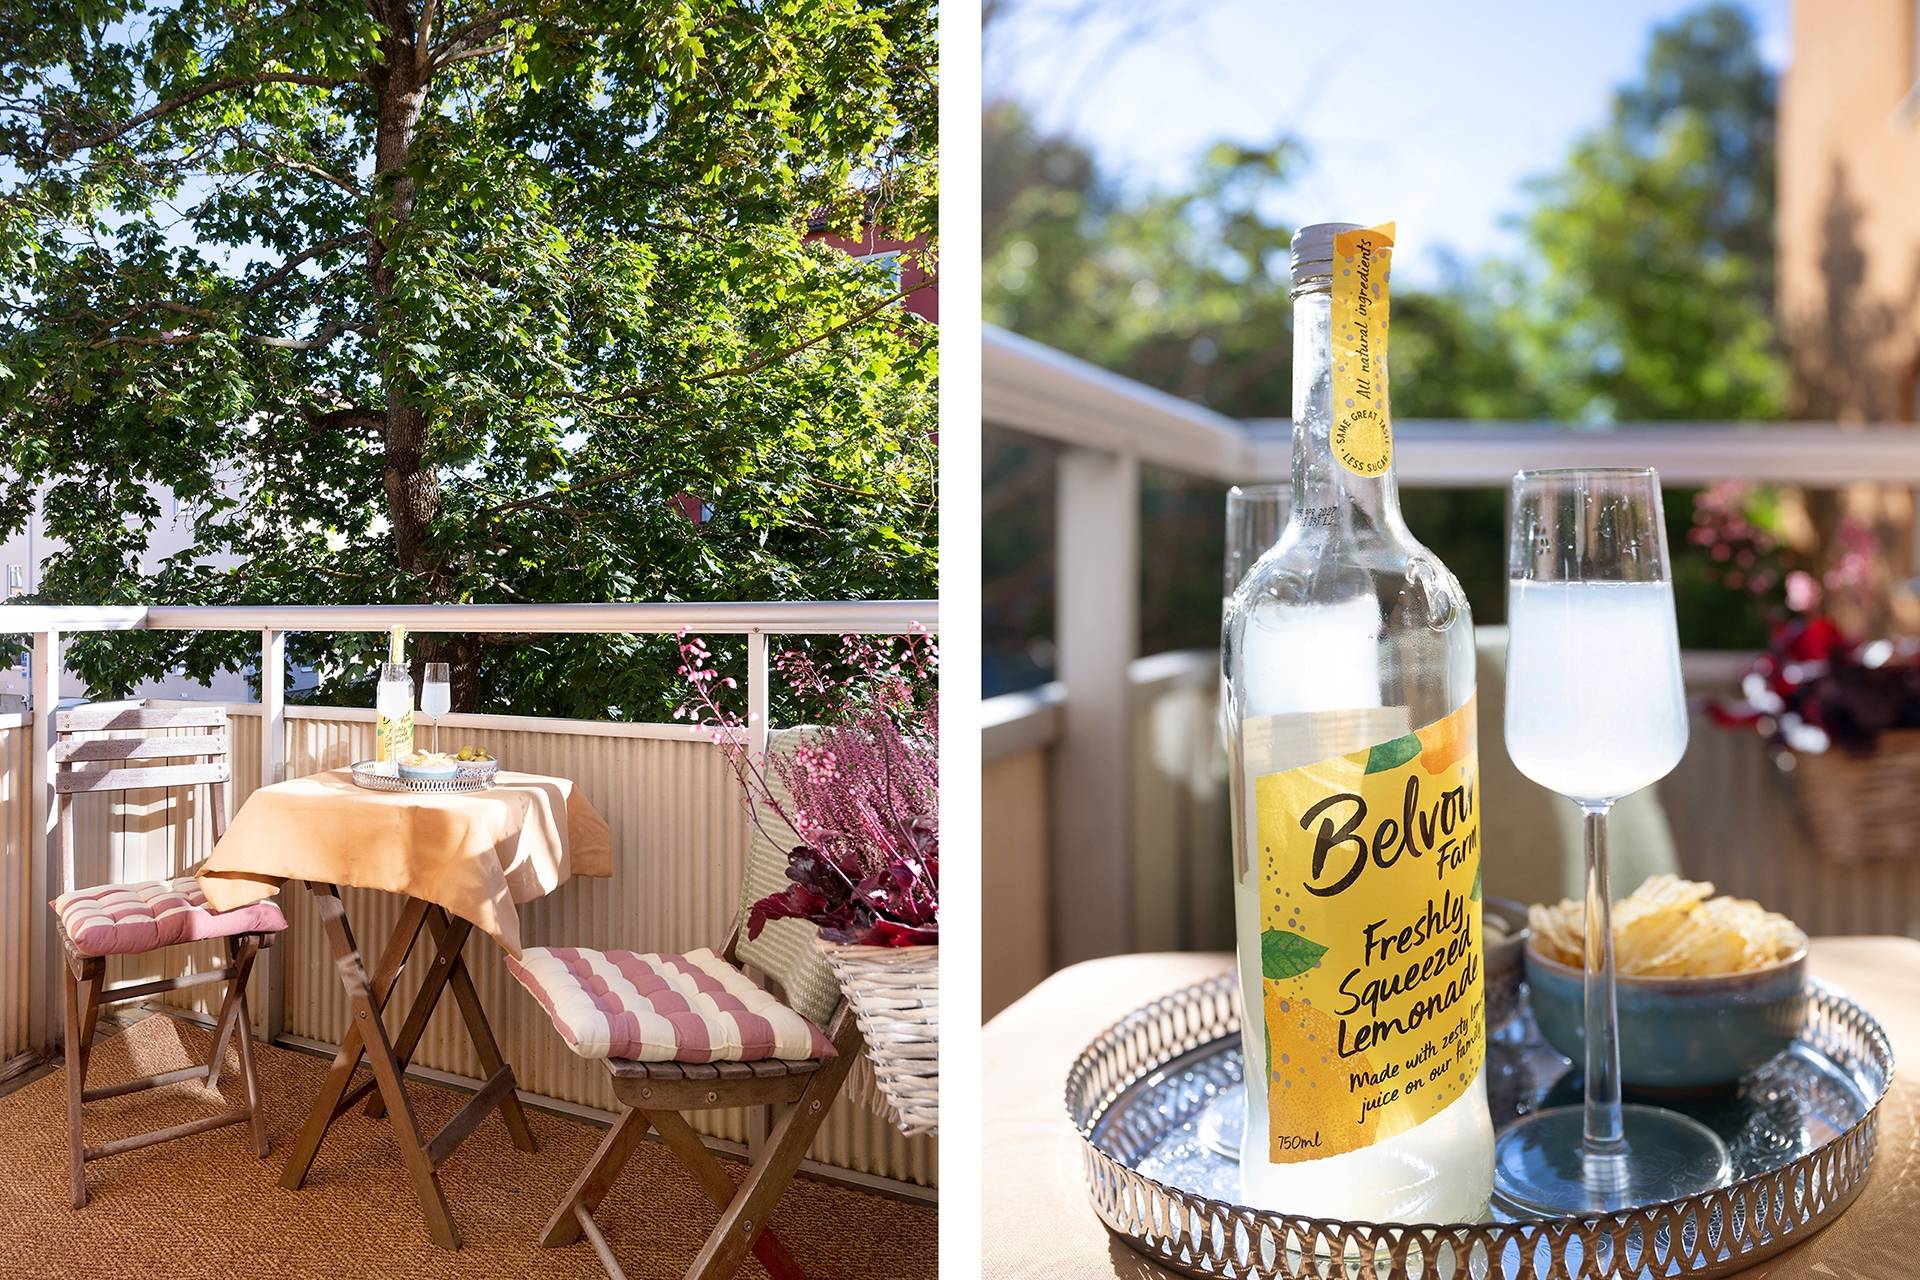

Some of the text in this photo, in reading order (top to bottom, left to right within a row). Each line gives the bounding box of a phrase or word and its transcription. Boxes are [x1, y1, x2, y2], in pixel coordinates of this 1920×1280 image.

[1354, 238, 1373, 400] All natural ingredients
[1336, 418, 1352, 445] SAME
[1350, 409, 1378, 421] GREAT
[1342, 452, 1389, 473] LESS SUGAR
[1436, 824, 1477, 881] Farm
[1362, 888, 1464, 967] Freshly
[1334, 913, 1473, 1018] Squeezed
[1338, 951, 1478, 1059] Lemonade
[1349, 1062, 1400, 1093] Made
[1405, 1040, 1439, 1070] with
[1442, 1016, 1469, 1050] zesty
[1357, 1088, 1400, 1125] juice
[1405, 1077, 1425, 1095] on
[1429, 1057, 1453, 1082] our
[1277, 1130, 1323, 1150] 750ml
